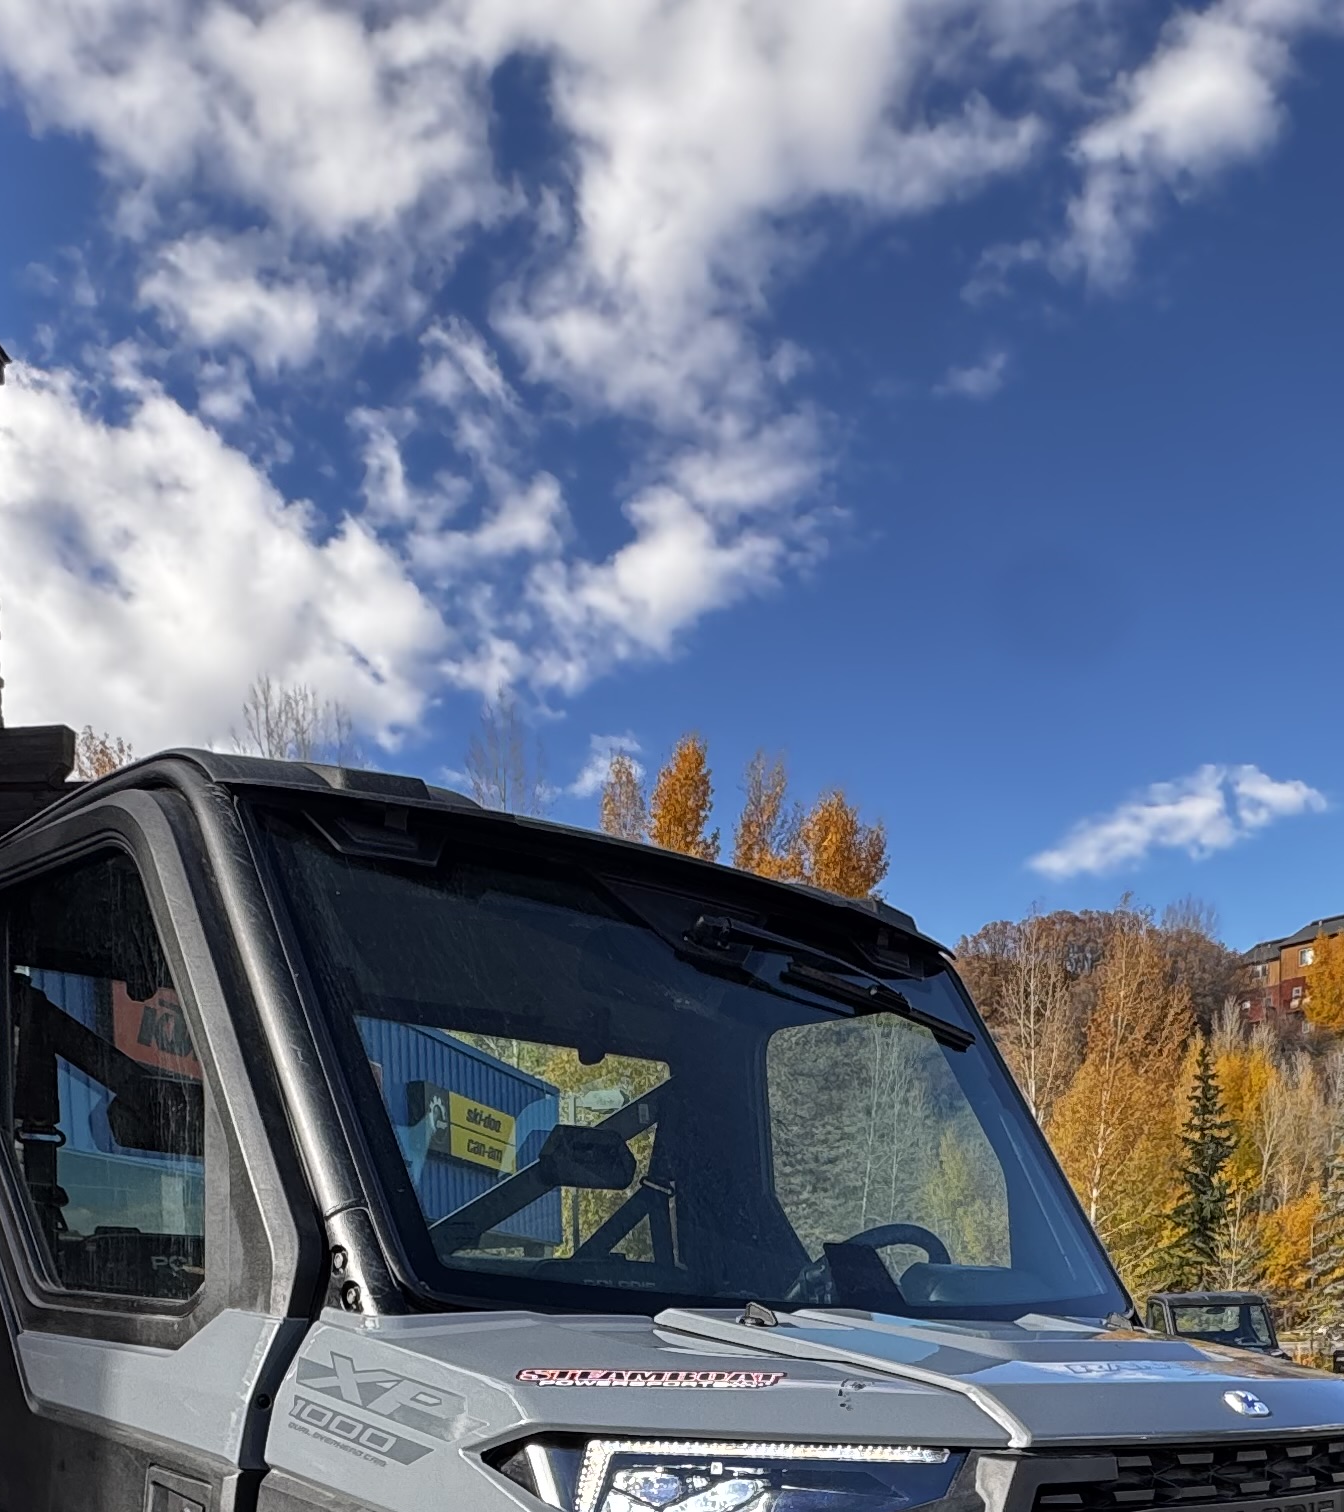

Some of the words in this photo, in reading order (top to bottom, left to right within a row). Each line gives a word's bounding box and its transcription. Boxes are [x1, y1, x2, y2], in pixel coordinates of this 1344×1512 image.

[465, 1107, 502, 1134] ski-doo
[466, 1138, 504, 1164] can-am
[296, 1351, 467, 1419] XP
[517, 1368, 786, 1384] STEAMBOAT
[290, 1396, 397, 1453] 1000
